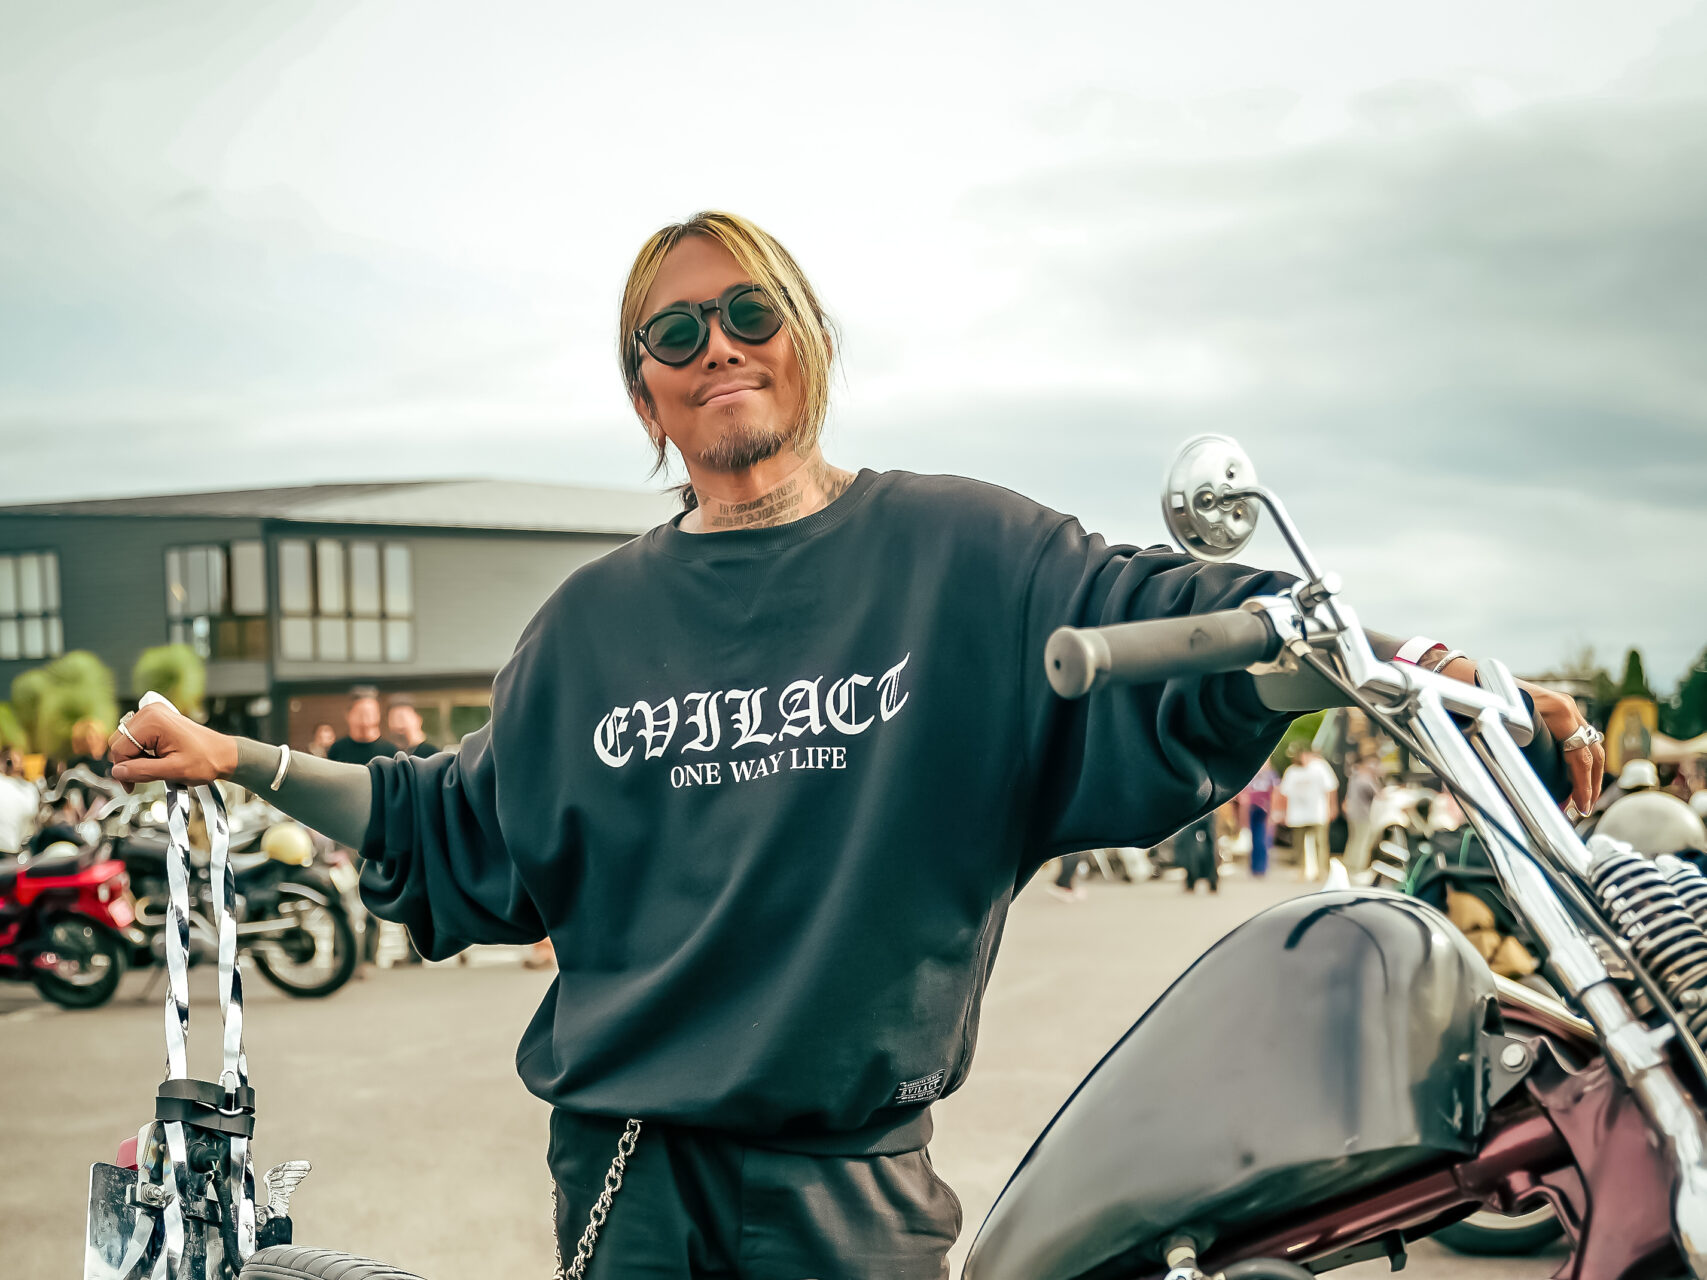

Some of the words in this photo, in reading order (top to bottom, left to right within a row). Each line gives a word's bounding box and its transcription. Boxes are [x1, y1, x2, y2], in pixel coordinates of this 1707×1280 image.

[594, 652, 910, 768] EVILACT
[670, 763, 721, 788] ONE
[729, 751, 784, 783] WAY
[790, 746, 847, 770] LIFE
